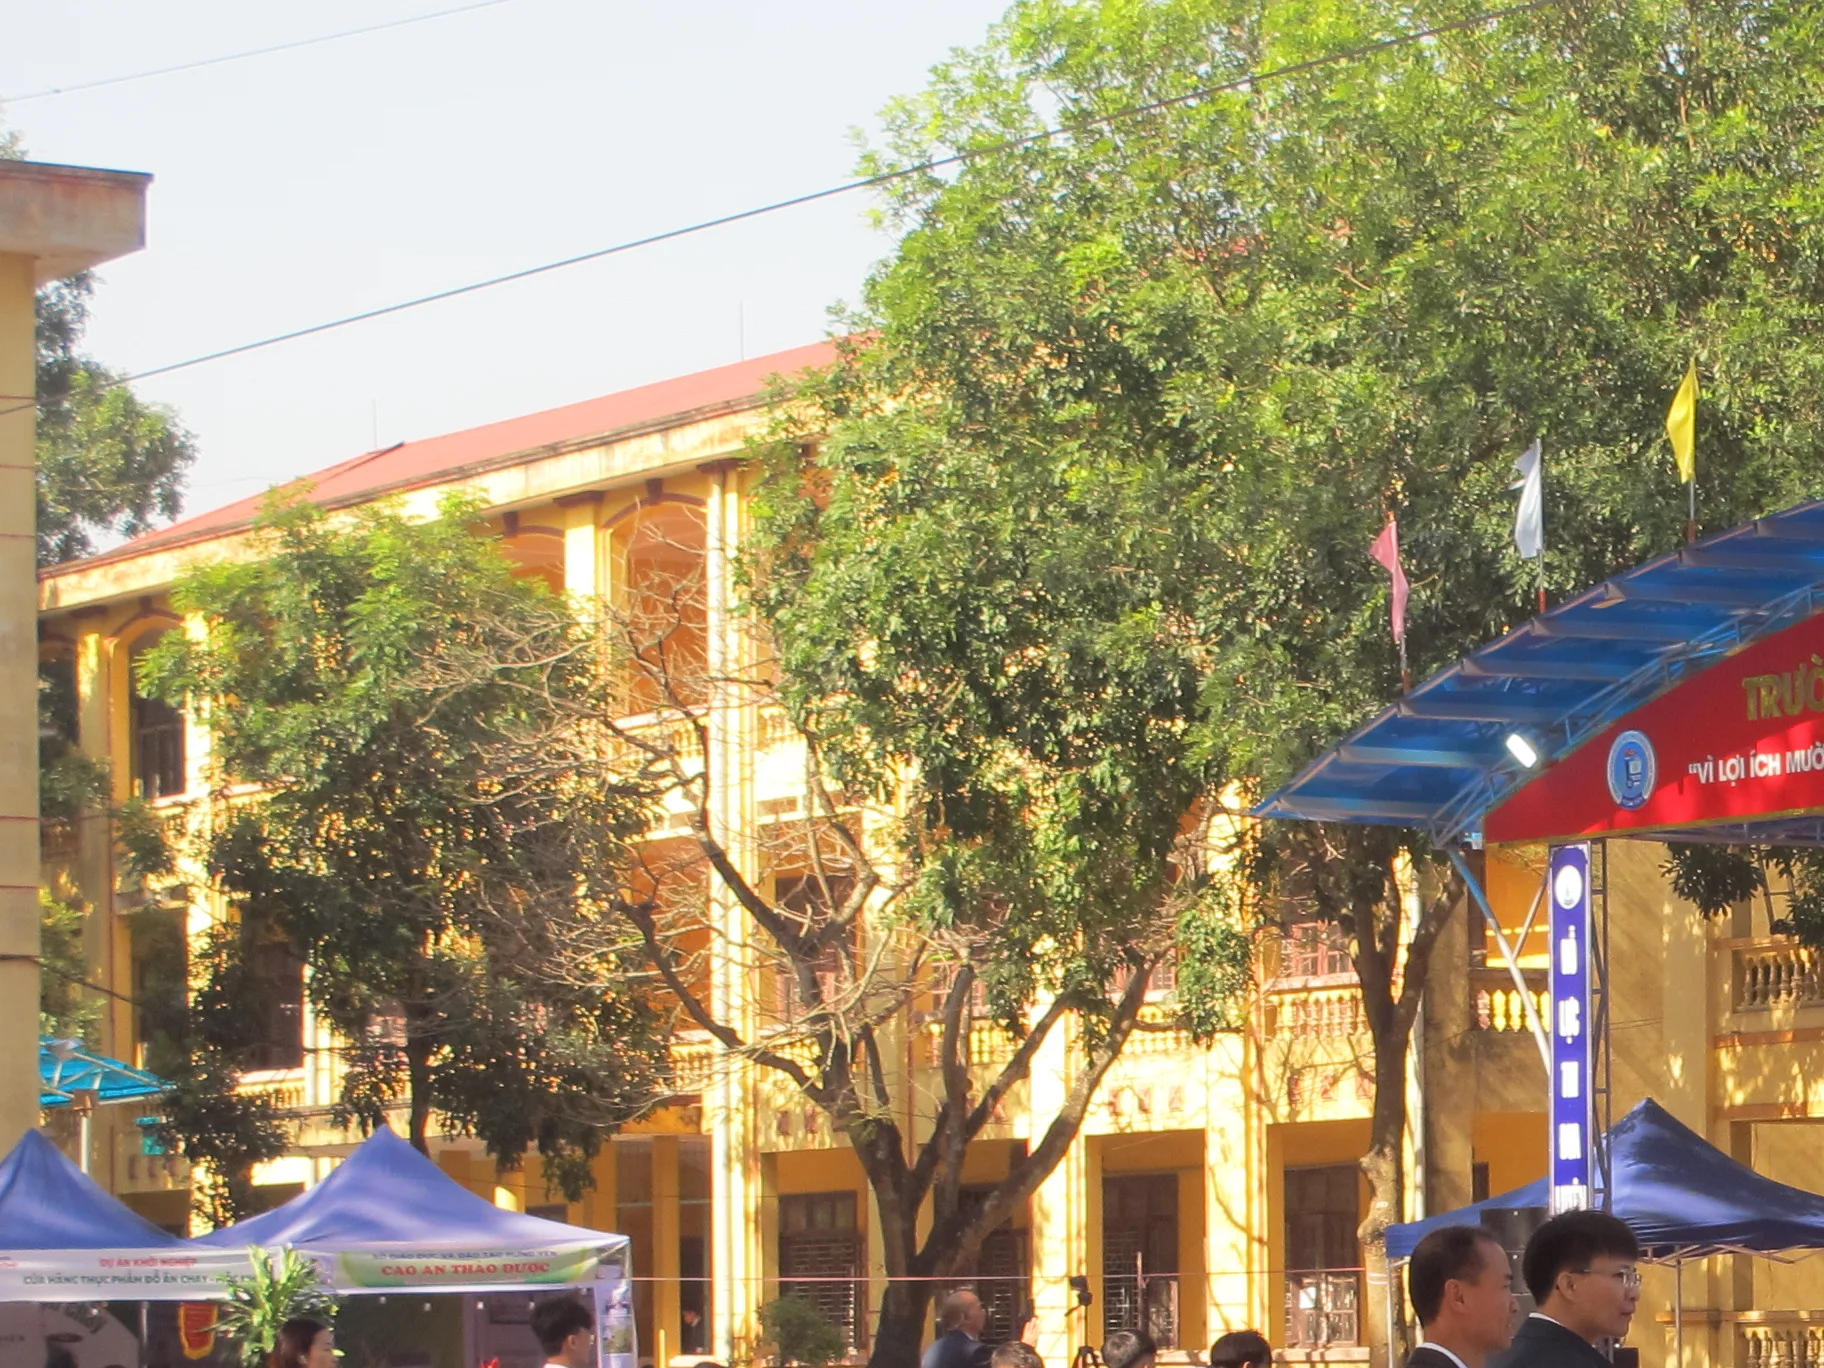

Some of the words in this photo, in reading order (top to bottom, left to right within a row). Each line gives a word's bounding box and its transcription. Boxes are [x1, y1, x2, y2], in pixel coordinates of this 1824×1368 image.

[1718, 758, 1745, 787] LỢI
[1750, 750, 1782, 778] ÍCH
[381, 1265, 418, 1276] CAO
[423, 1264, 446, 1275] AN
